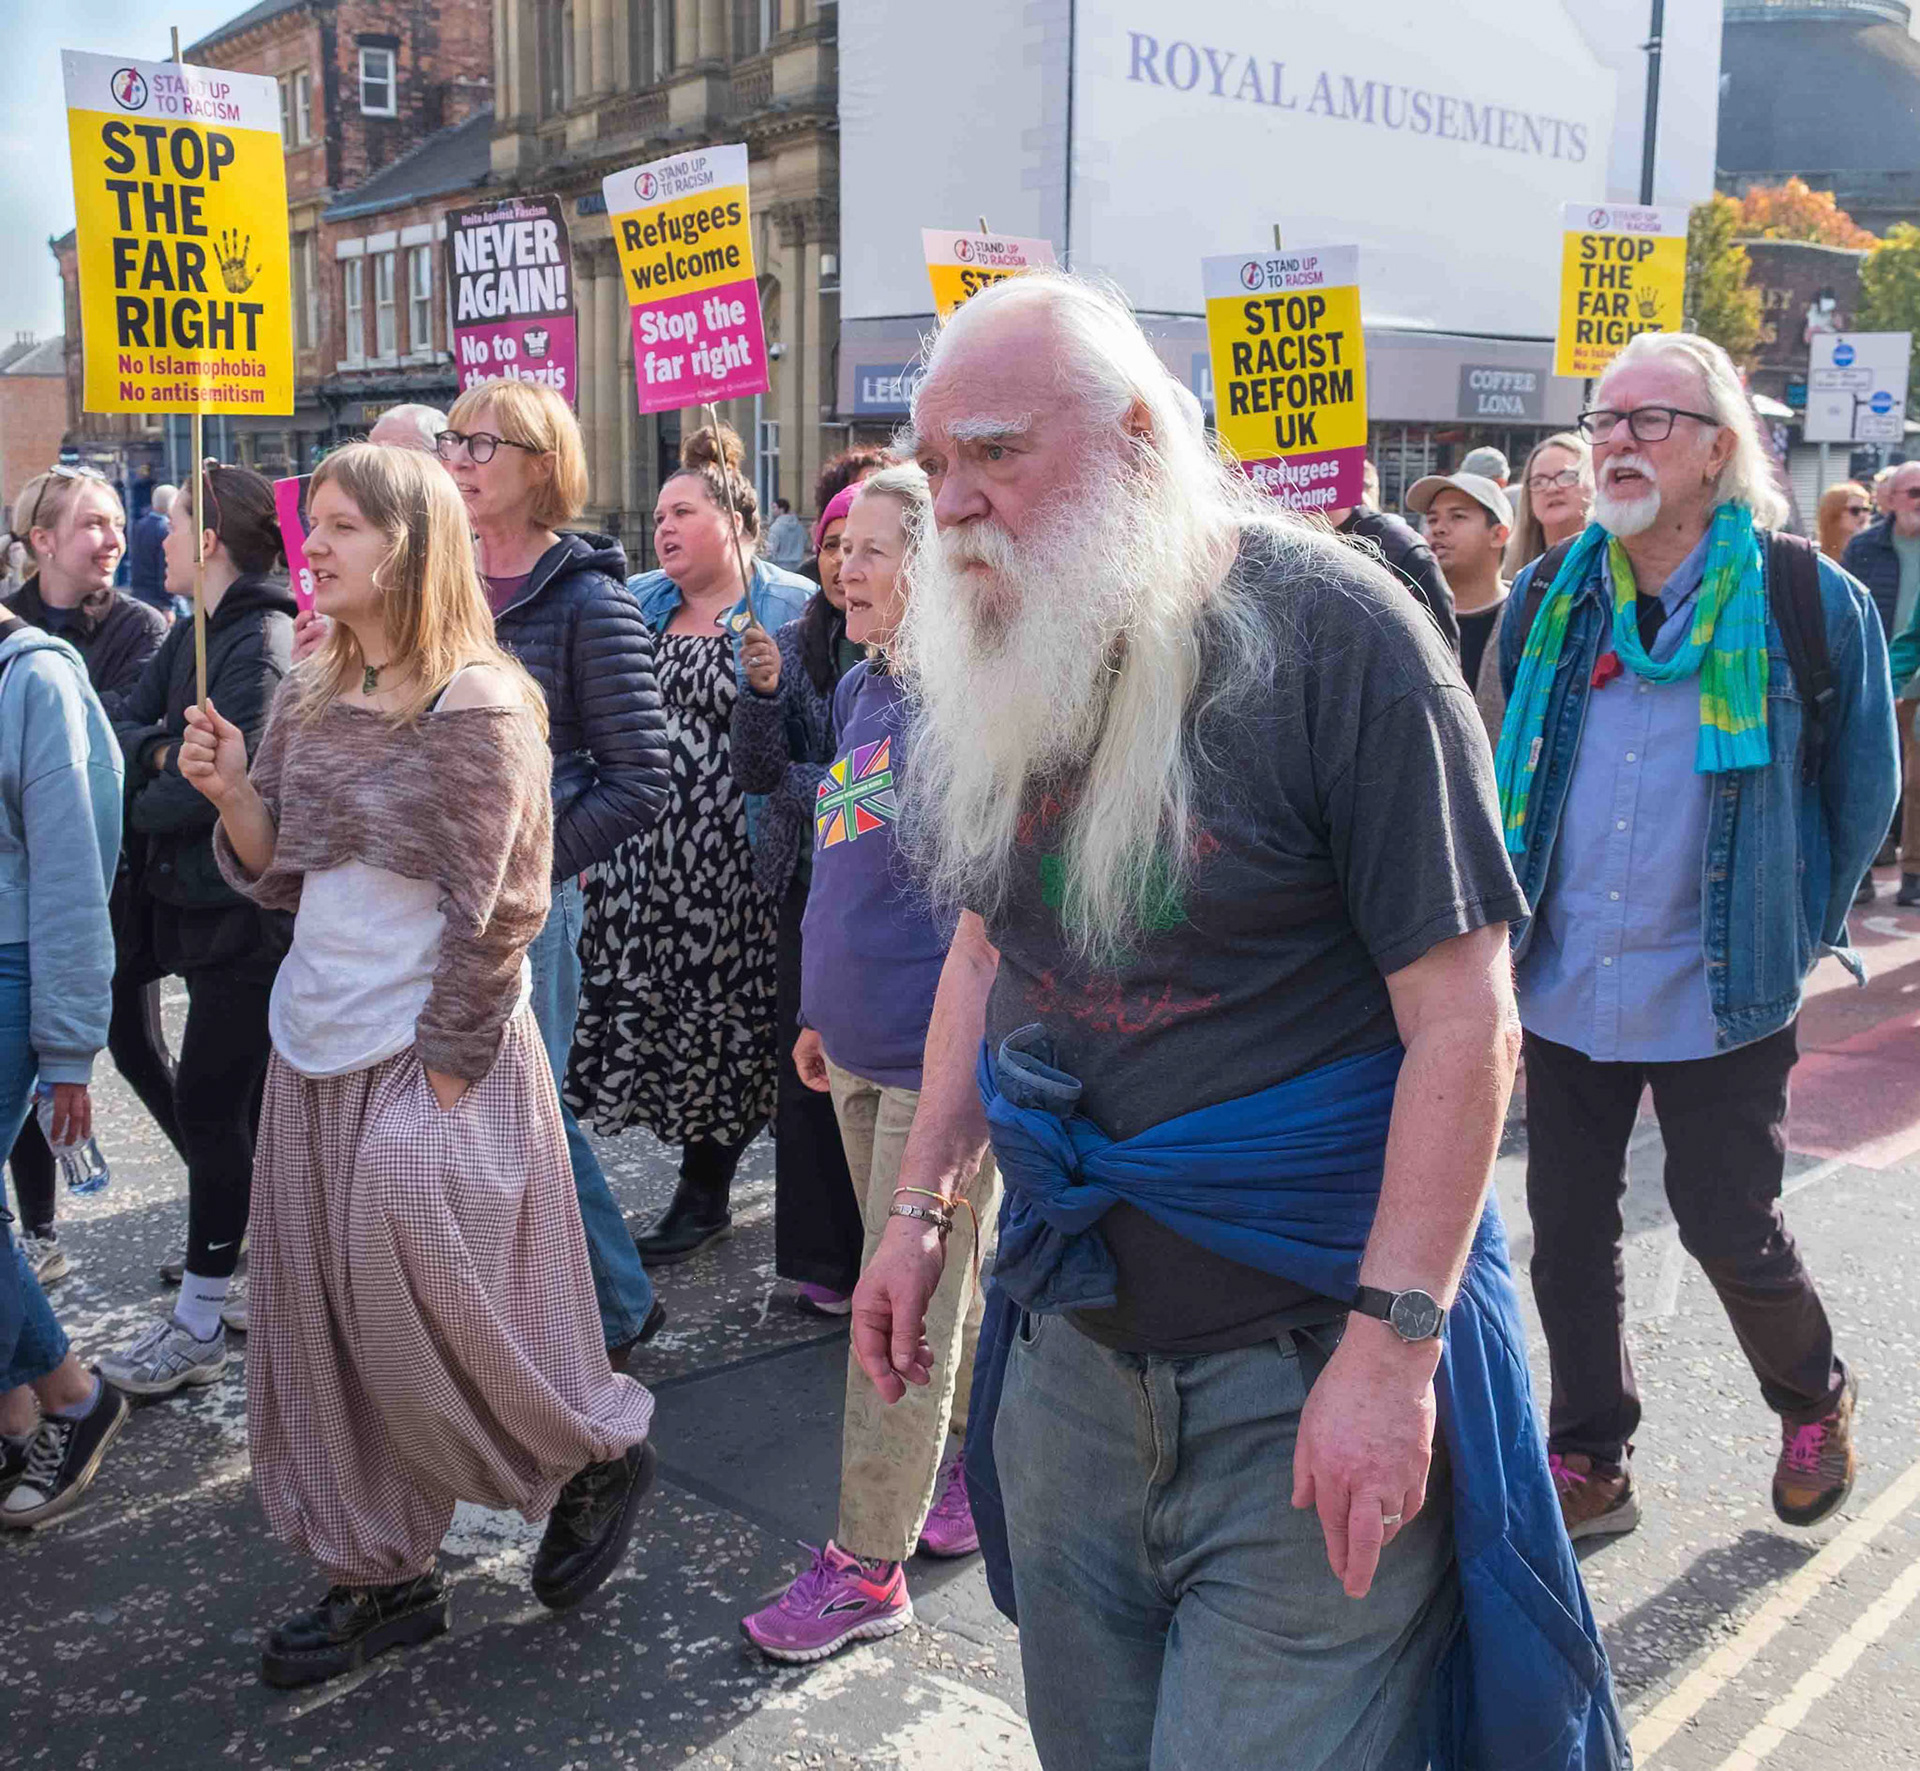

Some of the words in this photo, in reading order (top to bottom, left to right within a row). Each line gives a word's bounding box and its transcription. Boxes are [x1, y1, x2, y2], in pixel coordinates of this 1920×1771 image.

[209, 81, 230, 100] UP
[1126, 30, 1298, 111] ROYAL
[1305, 69, 1588, 164] AMUSEMENTS
[155, 94, 178, 114] TO
[183, 97, 240, 122] RACISM
[101, 120, 235, 181] STOP
[658, 162, 689, 182] STAND
[691, 157, 707, 172] UP
[660, 182, 673, 197] TO
[674, 171, 714, 193] RACISM
[105, 179, 208, 237] THE
[461, 213, 482, 226] Unite
[483, 210, 514, 224] Against
[515, 206, 548, 218] Fascism
[621, 201, 742, 251] Refugees
[454, 219, 560, 274] NEVER
[974, 241, 1004, 254] STAND
[1006, 244, 1019, 254] UP
[976, 253, 988, 265] TO
[990, 255, 1027, 266] RACISM
[1580, 235, 1654, 262] STOP
[112, 237, 208, 293] FAR
[631, 244, 740, 290] welcome
[1266, 259, 1300, 273] STAND
[1302, 257, 1318, 271] UP
[1267, 274, 1283, 288] TO
[1286, 270, 1323, 287] RACISM
[1579, 262, 1633, 290] THE
[458, 265, 567, 320] AGAIN!
[1578, 291, 1629, 318] FAR
[116, 295, 264, 352] RIGHT
[639, 309, 699, 344] Stop
[703, 296, 746, 331] the
[1244, 295, 1326, 336] STOP
[461, 335, 489, 366] No
[493, 334, 517, 362] to
[644, 351, 684, 384] far
[691, 334, 752, 379] right
[1232, 331, 1344, 376] RACIST
[118, 354, 143, 375] No
[148, 355, 266, 380] Islamophobia
[1469, 369, 1536, 392] COFFEE
[119, 381, 145, 402] No
[151, 382, 265, 403] antisemitism
[1229, 369, 1354, 416] REFORM
[1478, 394, 1525, 414] LONA
[1274, 411, 1319, 449] UK
[1252, 460, 1340, 487] Refugees
